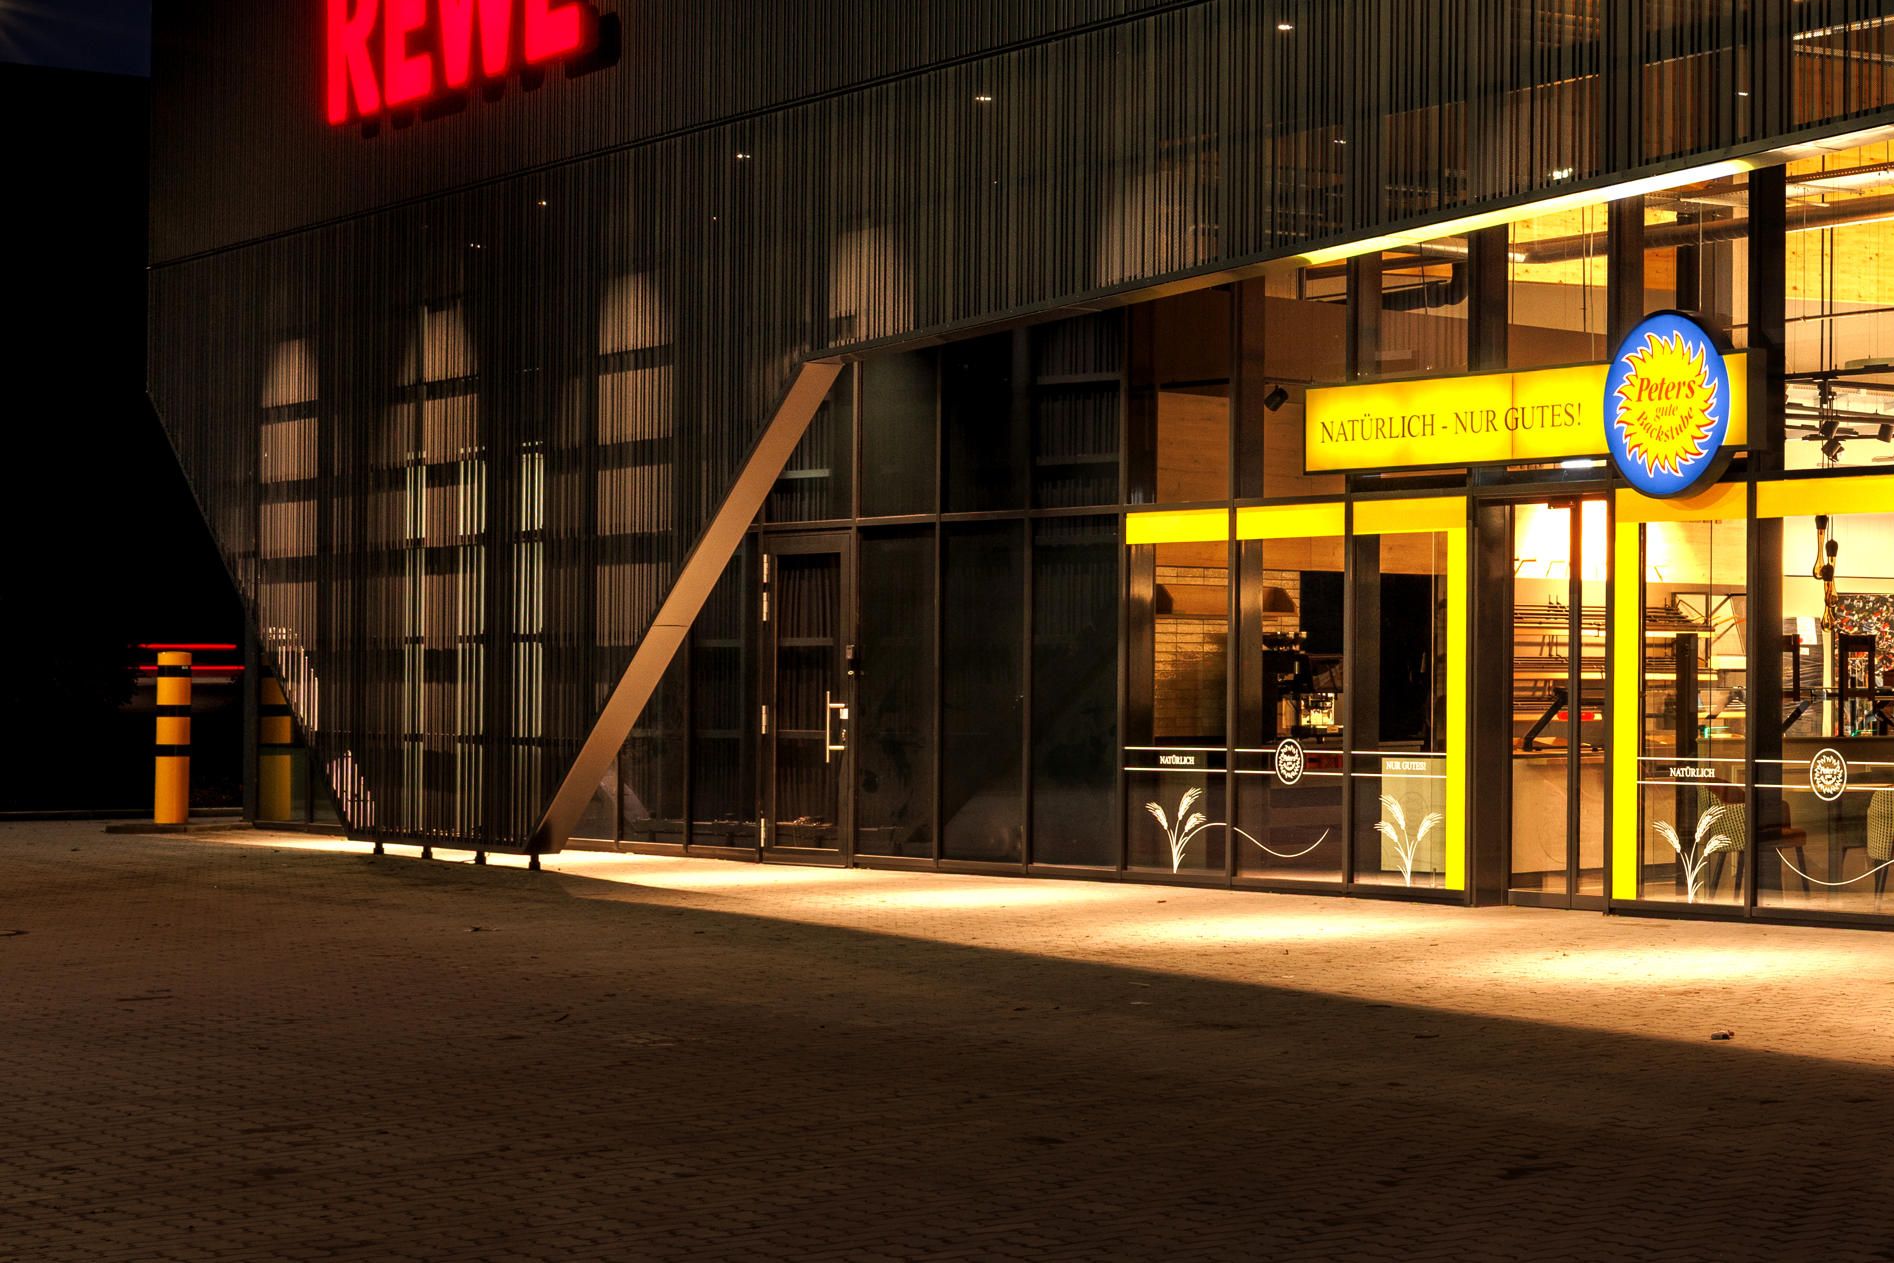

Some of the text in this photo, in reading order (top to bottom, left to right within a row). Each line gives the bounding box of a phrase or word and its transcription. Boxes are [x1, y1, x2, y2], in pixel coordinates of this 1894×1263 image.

[1636, 377, 1697, 402] Peters
[1654, 403, 1679, 422] gute
[1320, 413, 1436, 444] NATÜRLICH
[1454, 409, 1498, 434] NUR
[1504, 402, 1582, 432] GUTES!
[1637, 407, 1694, 442] Backstube
[1159, 754, 1195, 765] NATÜRLICH
[1386, 761, 1401, 770] NUR
[1669, 766, 1715, 778] NATÜRLICH
